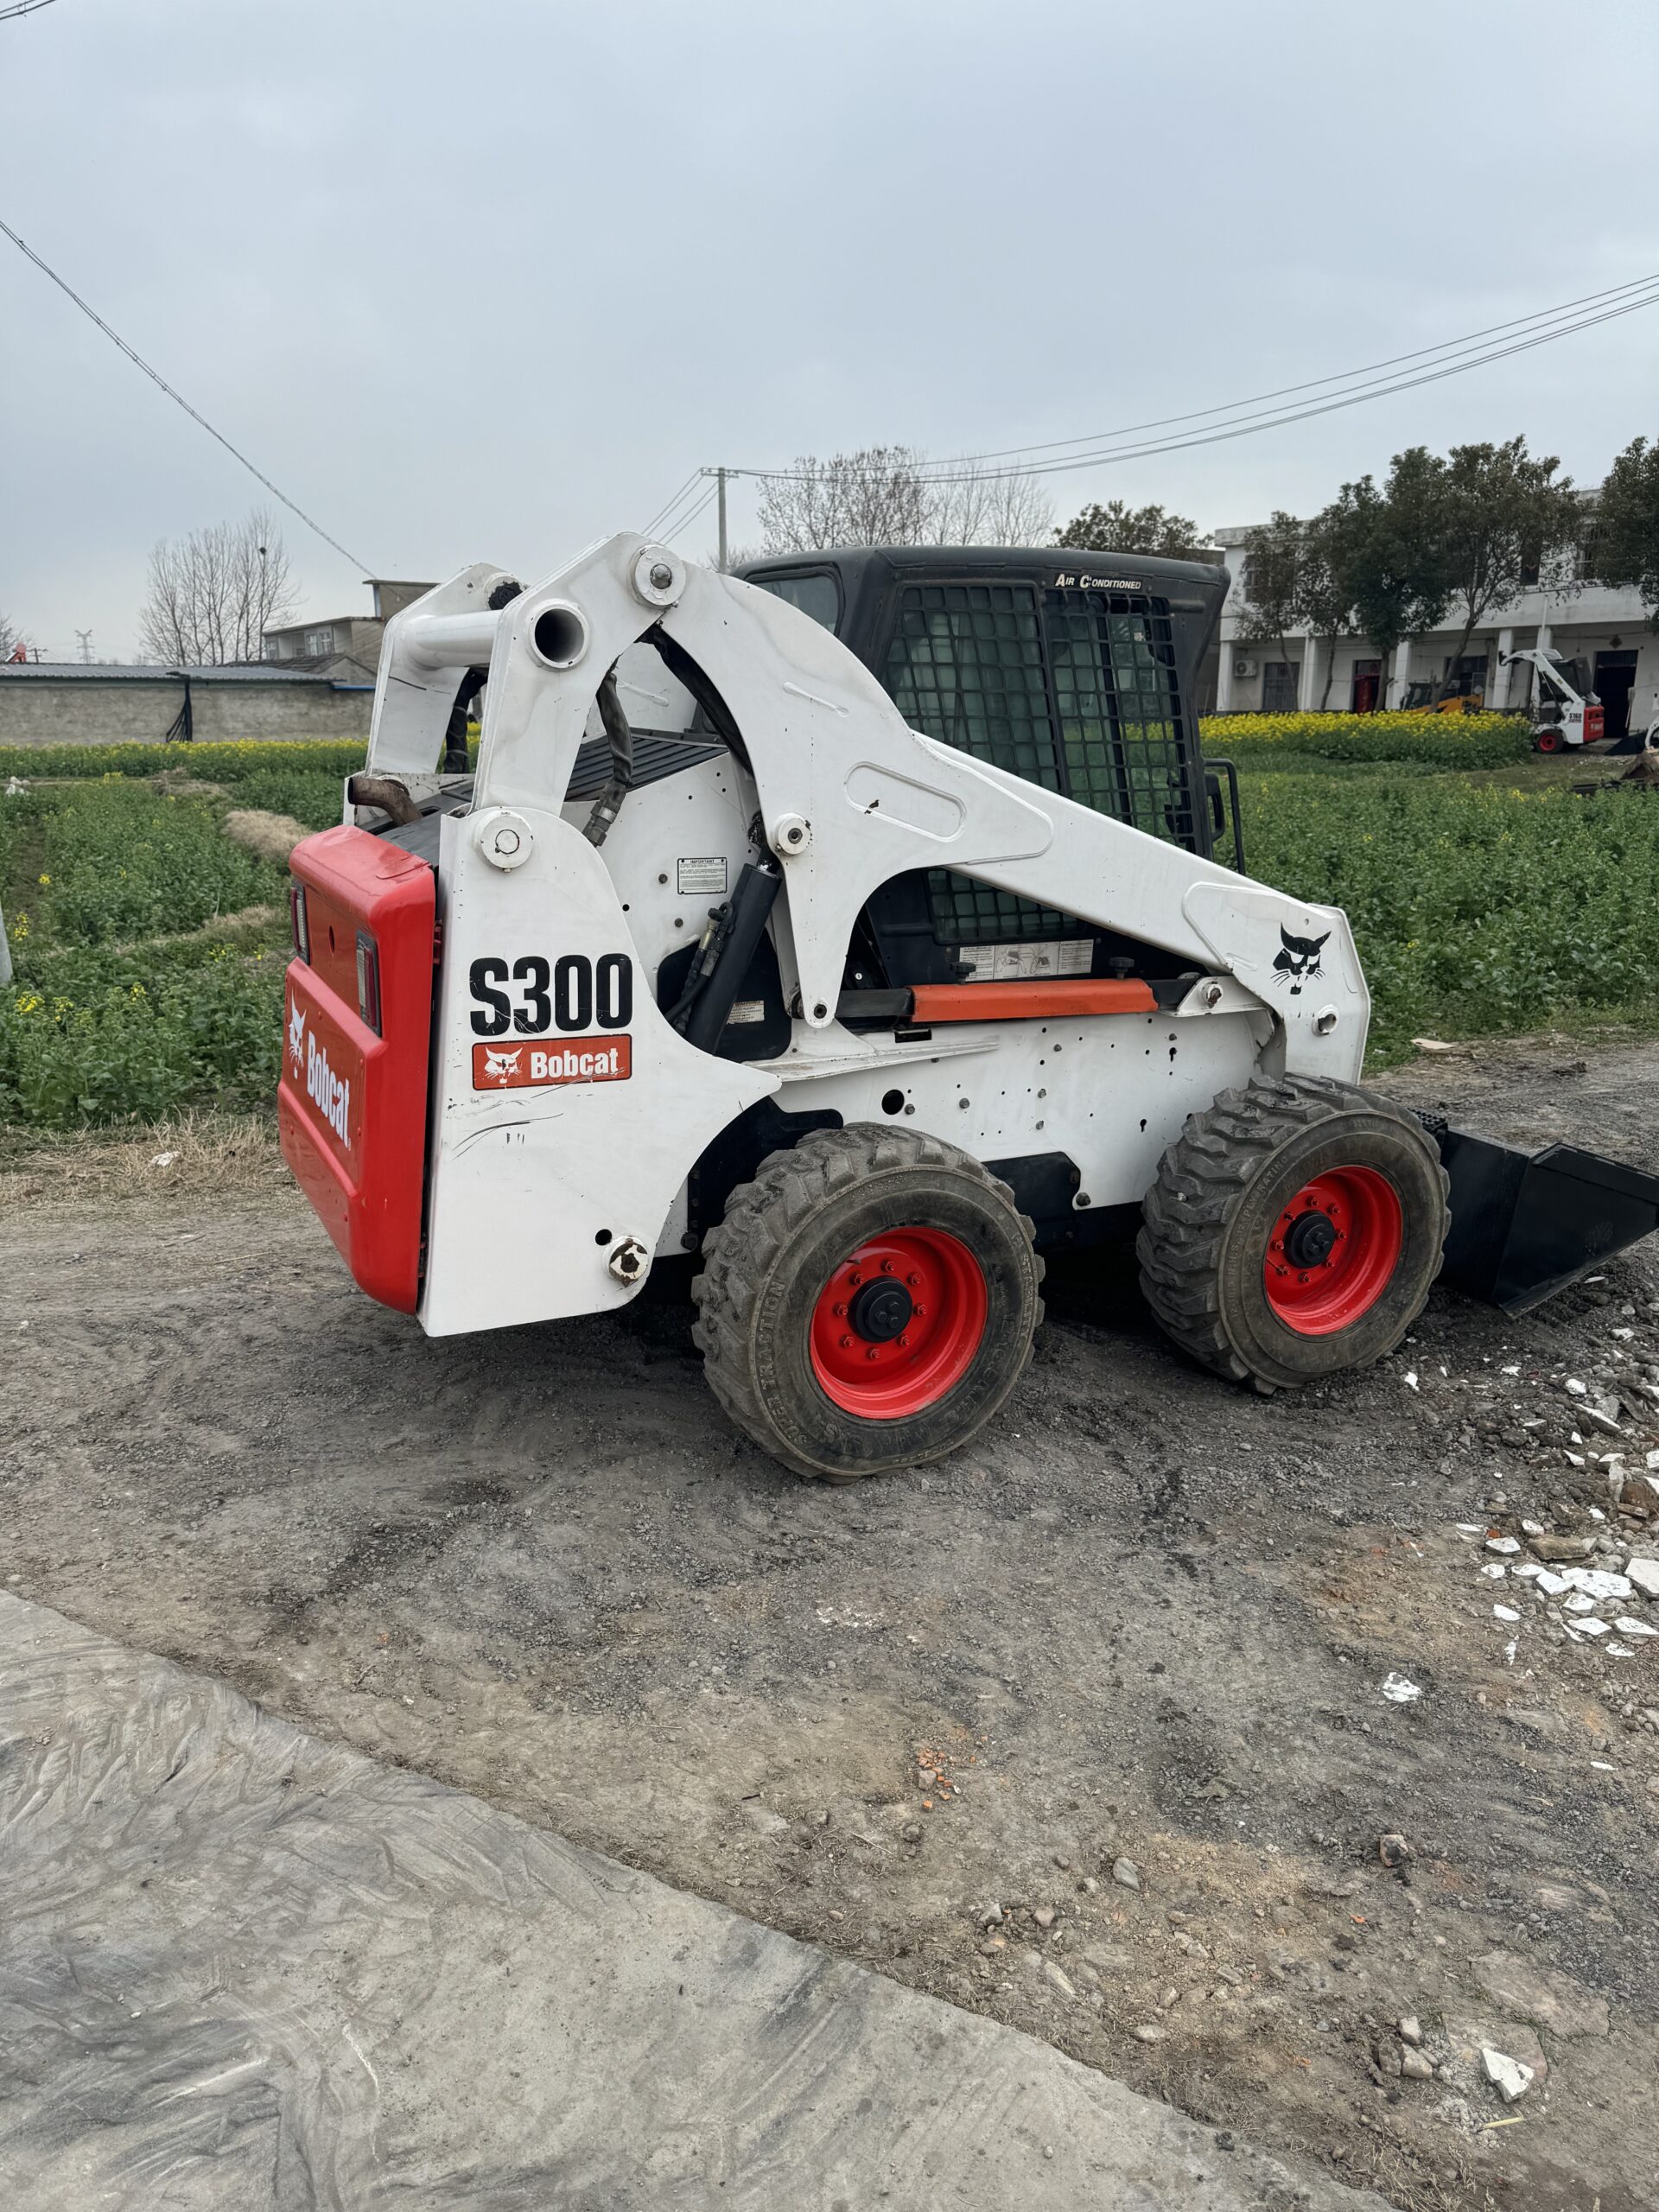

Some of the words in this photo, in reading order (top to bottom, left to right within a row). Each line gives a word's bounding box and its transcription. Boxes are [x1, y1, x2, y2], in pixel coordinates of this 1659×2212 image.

[1055, 574, 1076, 587] AIR
[1079, 575, 1141, 589] CONDITIONED
[469, 953, 632, 1036] S300
[531, 1047, 619, 1079] Bobcat
[307, 1029, 349, 1148] Bobcat
[1243, 1195, 1255, 1217] PLY
[758, 1281, 785, 1390] TRACTION
[766, 1395, 808, 1445] SUPER
